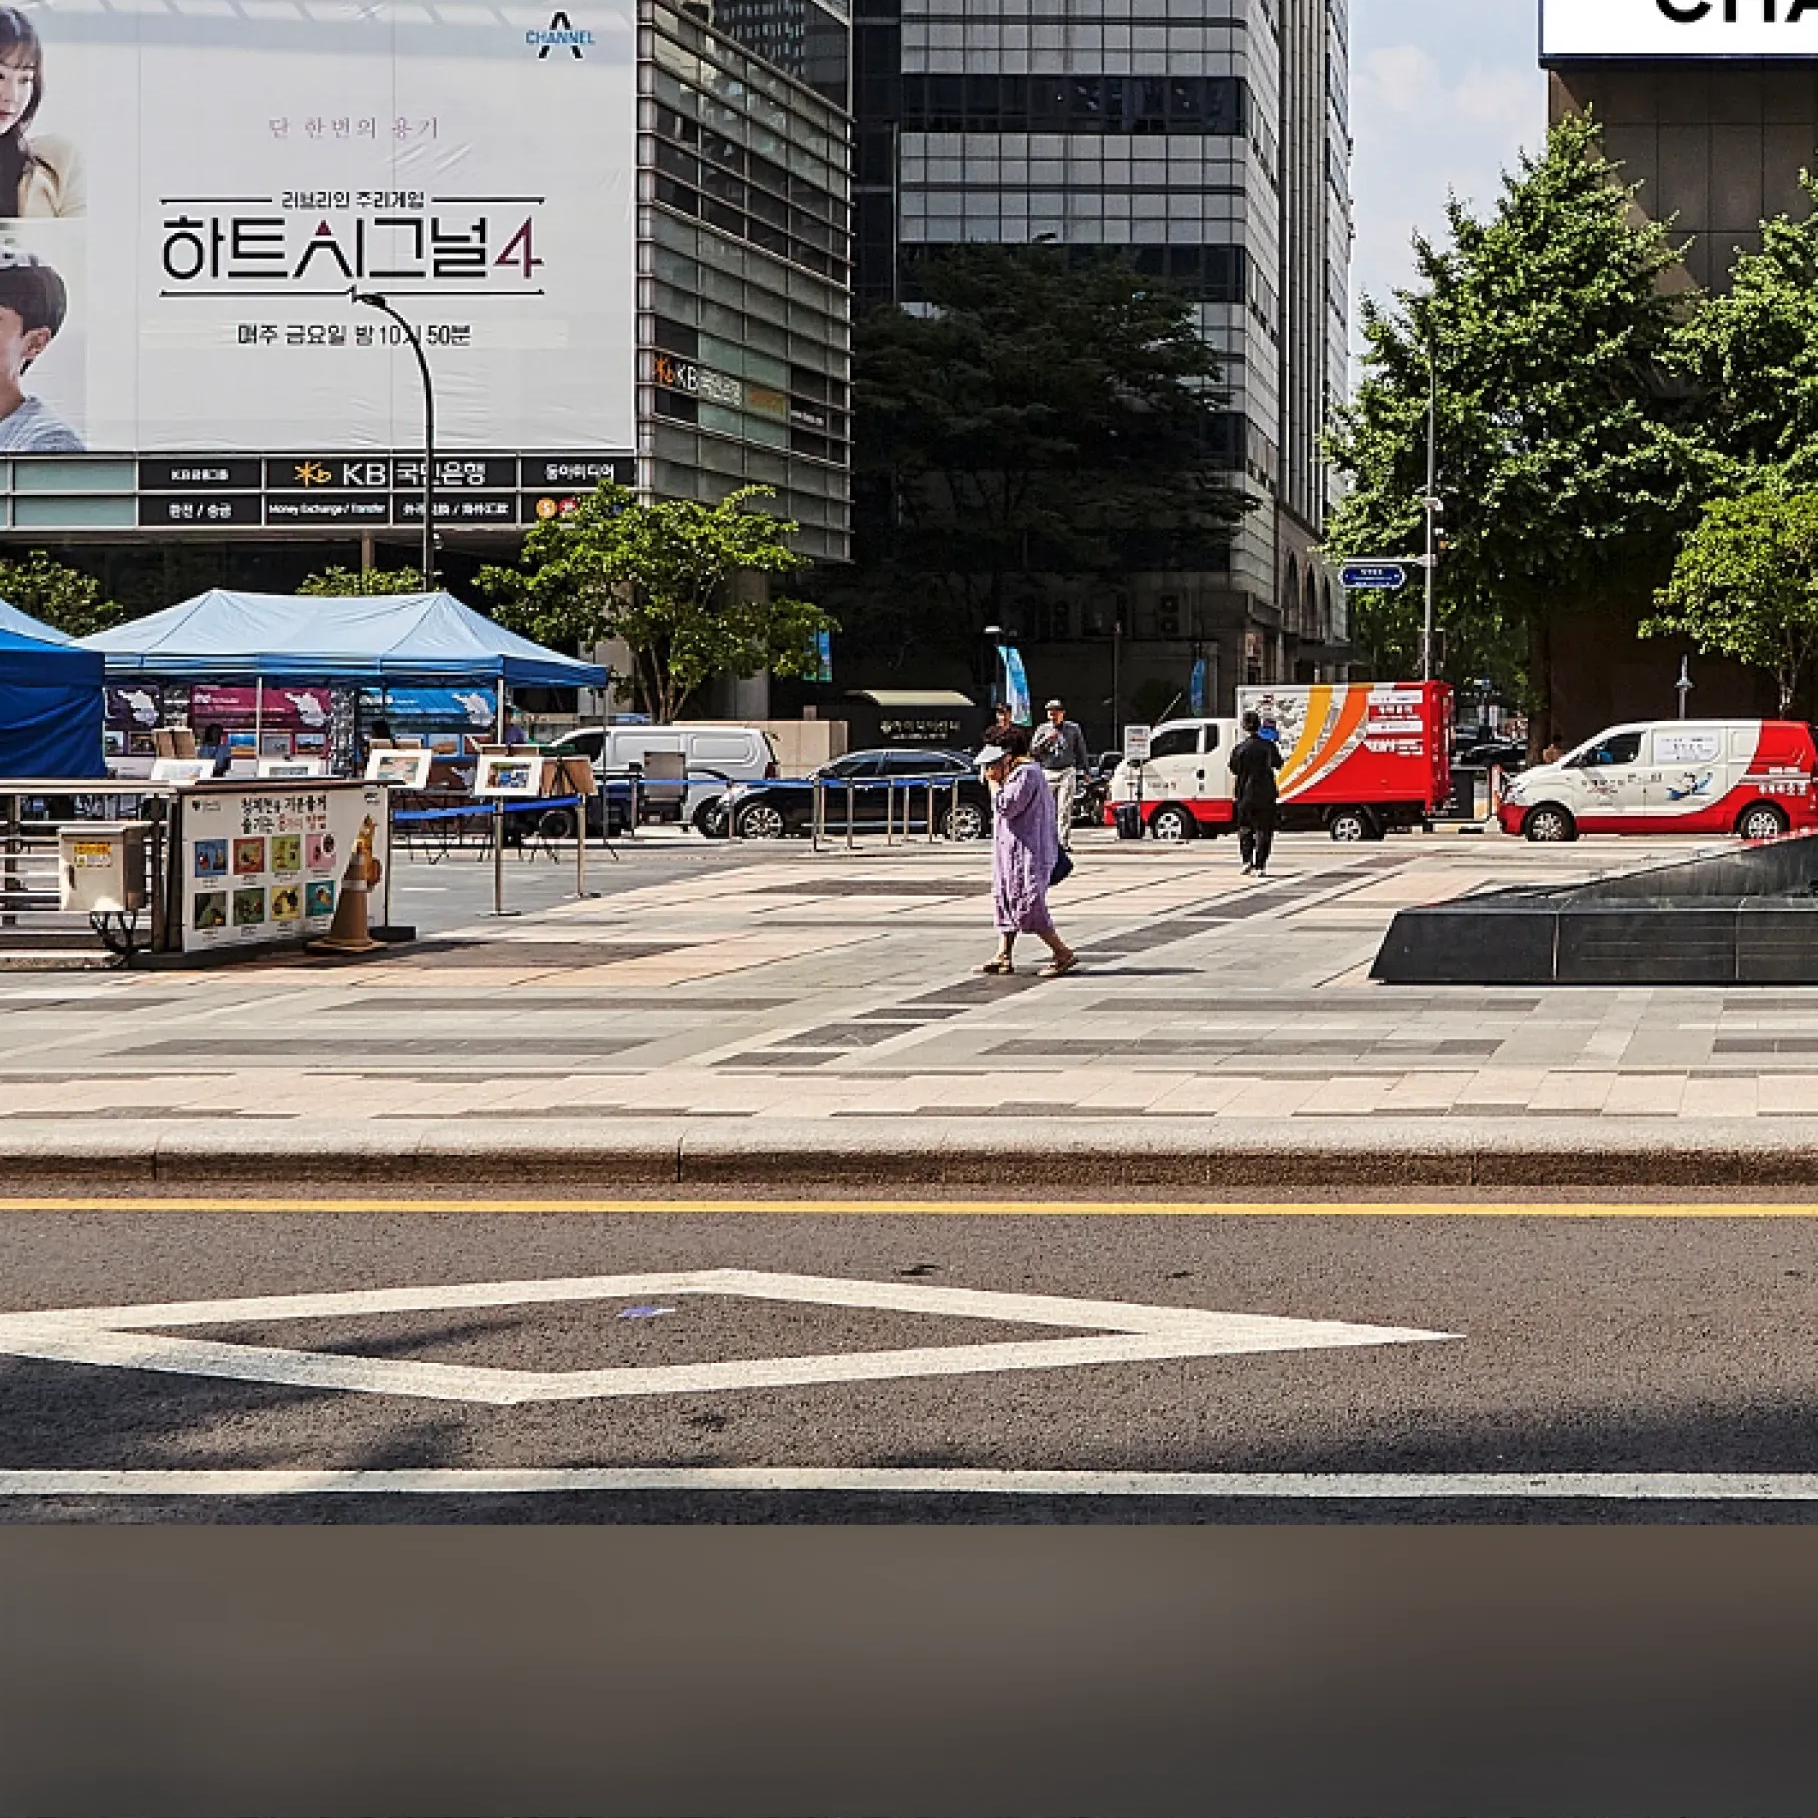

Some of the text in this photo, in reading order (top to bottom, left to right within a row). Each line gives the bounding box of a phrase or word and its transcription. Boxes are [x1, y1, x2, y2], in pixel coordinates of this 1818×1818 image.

[525, 29, 596, 46] CHANNEL
[268, 116, 290, 139] 단
[237, 324, 279, 346] 매주
[285, 324, 347, 346] 금요일
[355, 324, 374, 346] 밤
[426, 324, 471, 346] 50분
[343, 462, 387, 486] KB
[268, 503, 299, 516] Money
